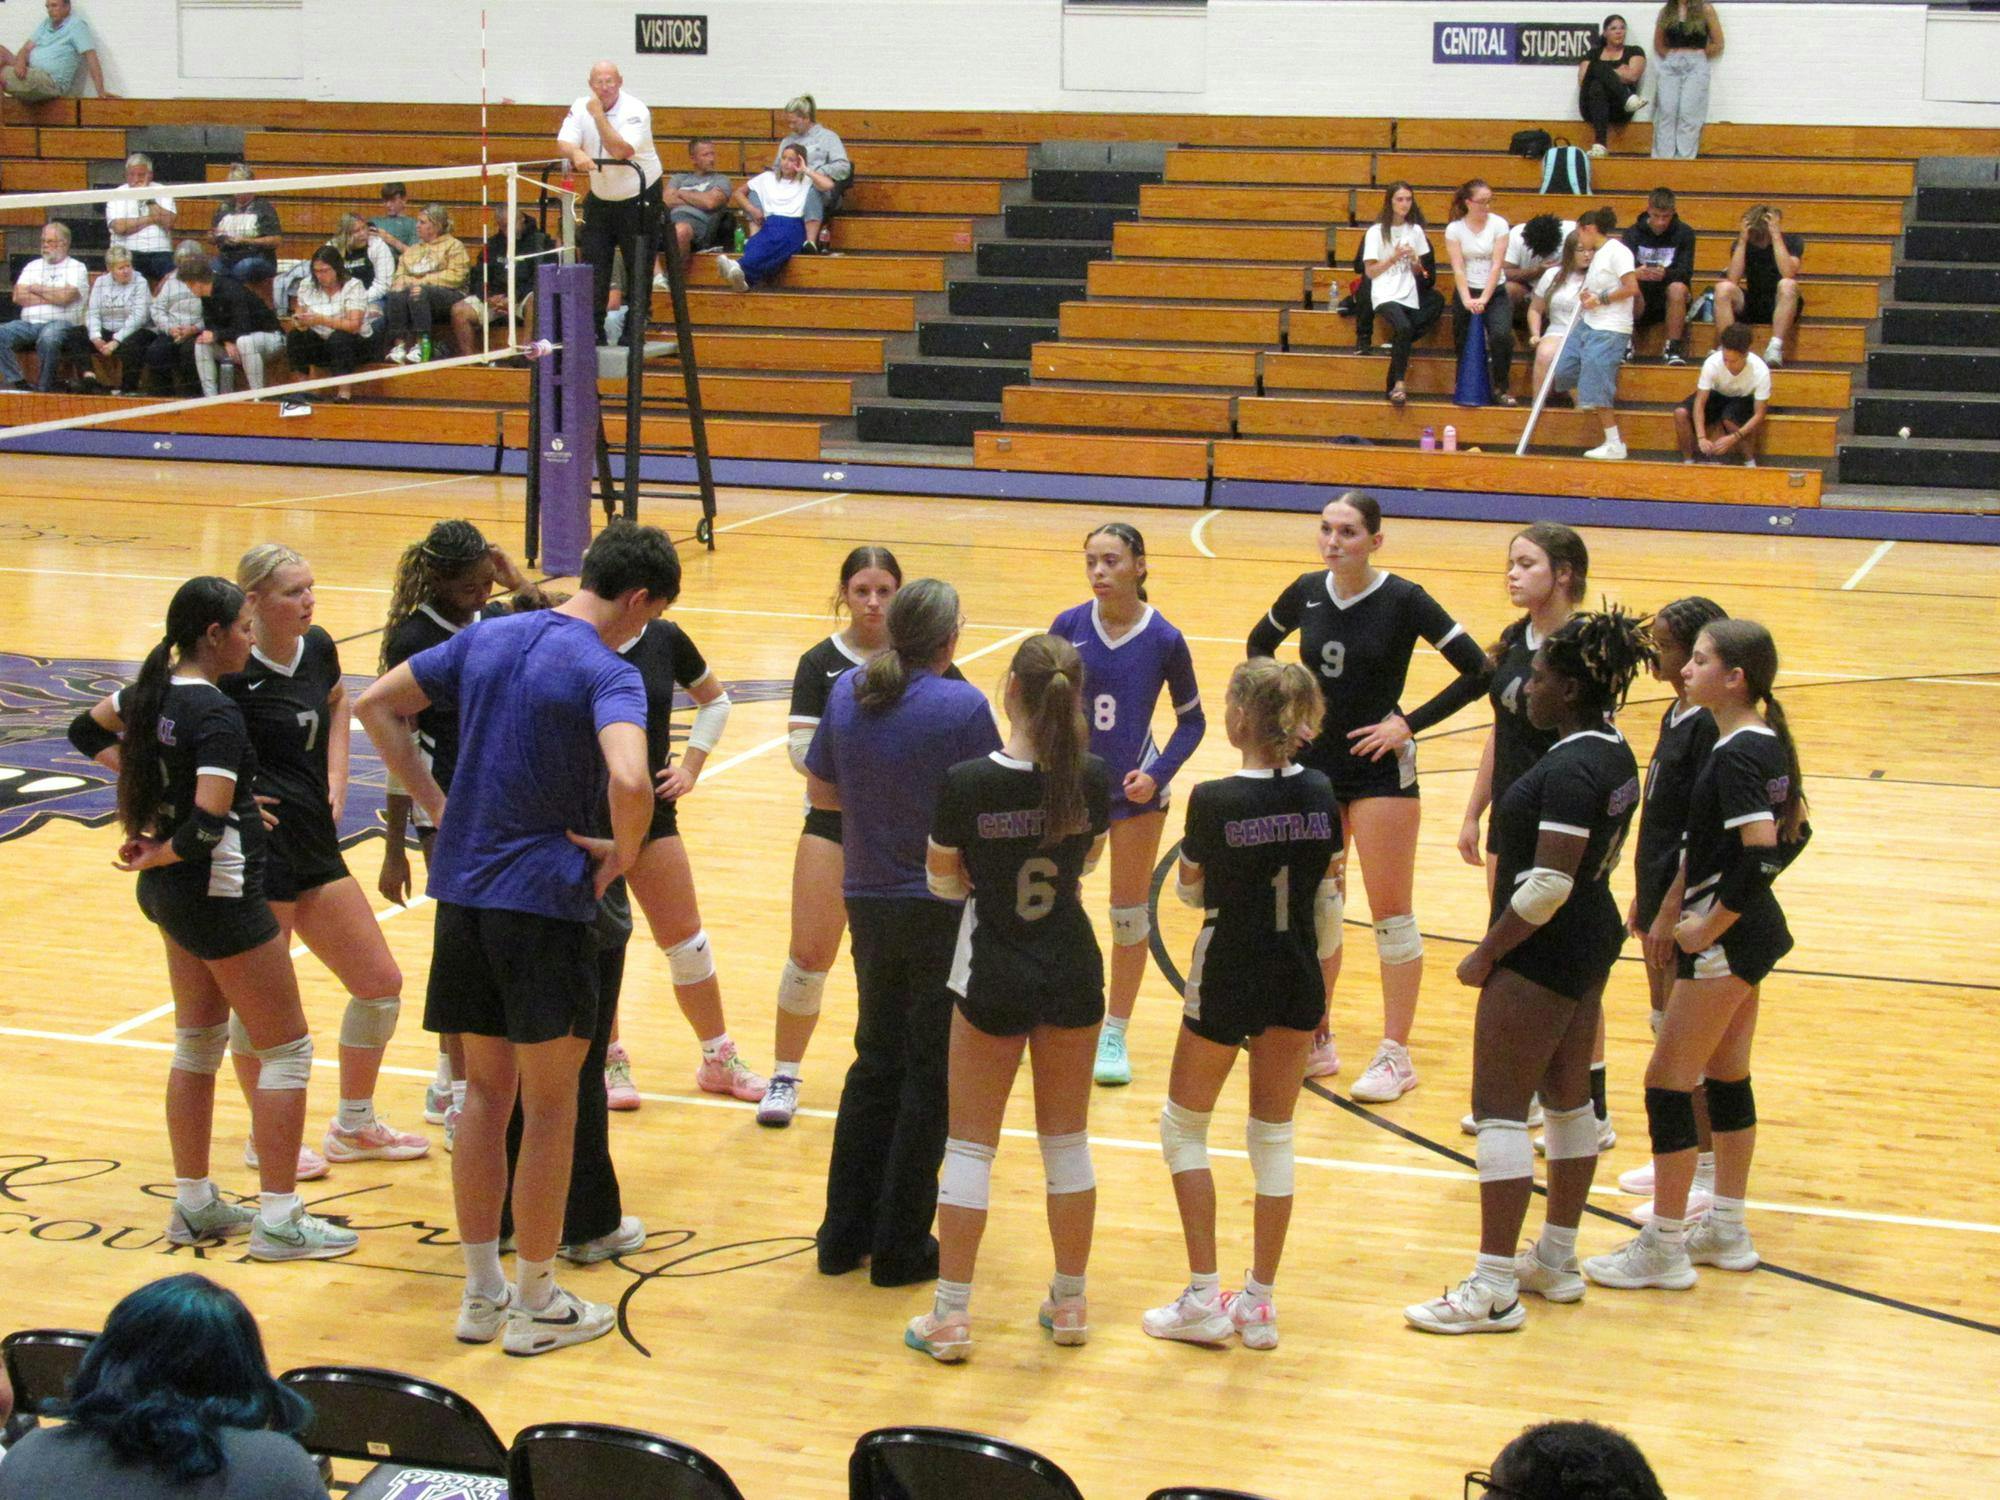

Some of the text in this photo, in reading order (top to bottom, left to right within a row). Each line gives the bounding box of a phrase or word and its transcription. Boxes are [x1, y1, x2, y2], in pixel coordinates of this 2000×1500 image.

[640, 19, 702, 49] VISITORS
[1441, 27, 1591, 58] CENTRAL STUDENTS
[1320, 640, 1346, 678] 9
[296, 709, 319, 751] 7
[1094, 694, 1116, 731] 8
[1224, 811, 1332, 847] CENTRAL
[1016, 857, 1058, 922] 6
[1271, 865, 1289, 932] 1
